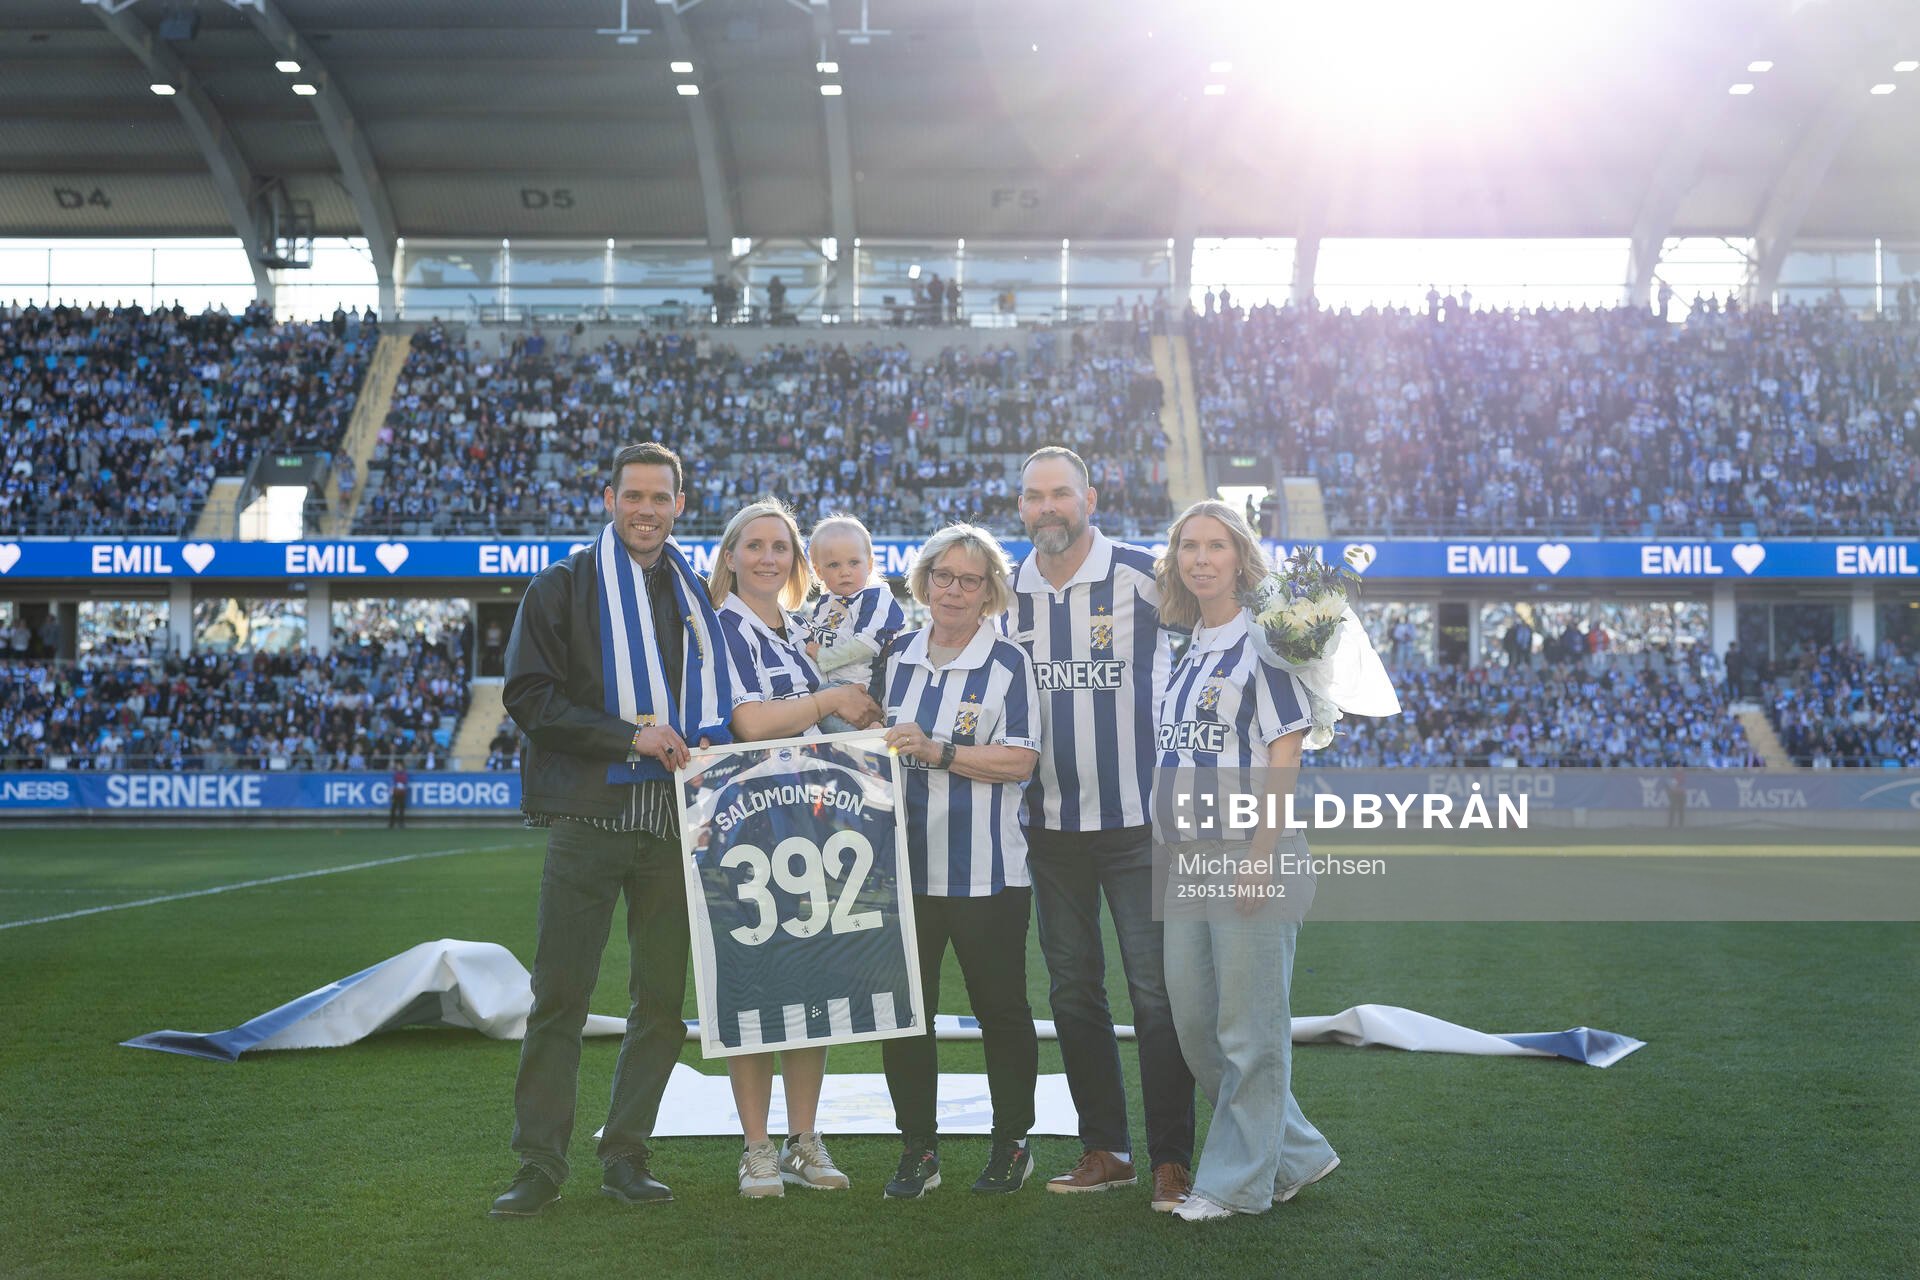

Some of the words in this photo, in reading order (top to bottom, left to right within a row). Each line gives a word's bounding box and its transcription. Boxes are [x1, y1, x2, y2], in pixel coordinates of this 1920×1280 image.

[53, 187, 110, 209] D4
[520, 188, 574, 209] D5
[991, 188, 1040, 209] F5
[91, 545, 173, 574] EMIL
[285, 545, 367, 574] EMIL
[1447, 545, 1529, 575] EMIL
[1641, 545, 1724, 575] EMIL
[1836, 545, 1919, 575] EMIL
[1033, 662, 1121, 689] RNEKE
[1158, 721, 1224, 752] RNEKE
[106, 774, 261, 807] SERNEKE
[324, 783, 365, 804] IFK
[371, 782, 509, 805] GTEBORG
[1643, 787, 1711, 808] RATA
[1738, 787, 1808, 808] RASTA
[715, 784, 865, 832] SALOMONSSON
[719, 829, 884, 946] 392
